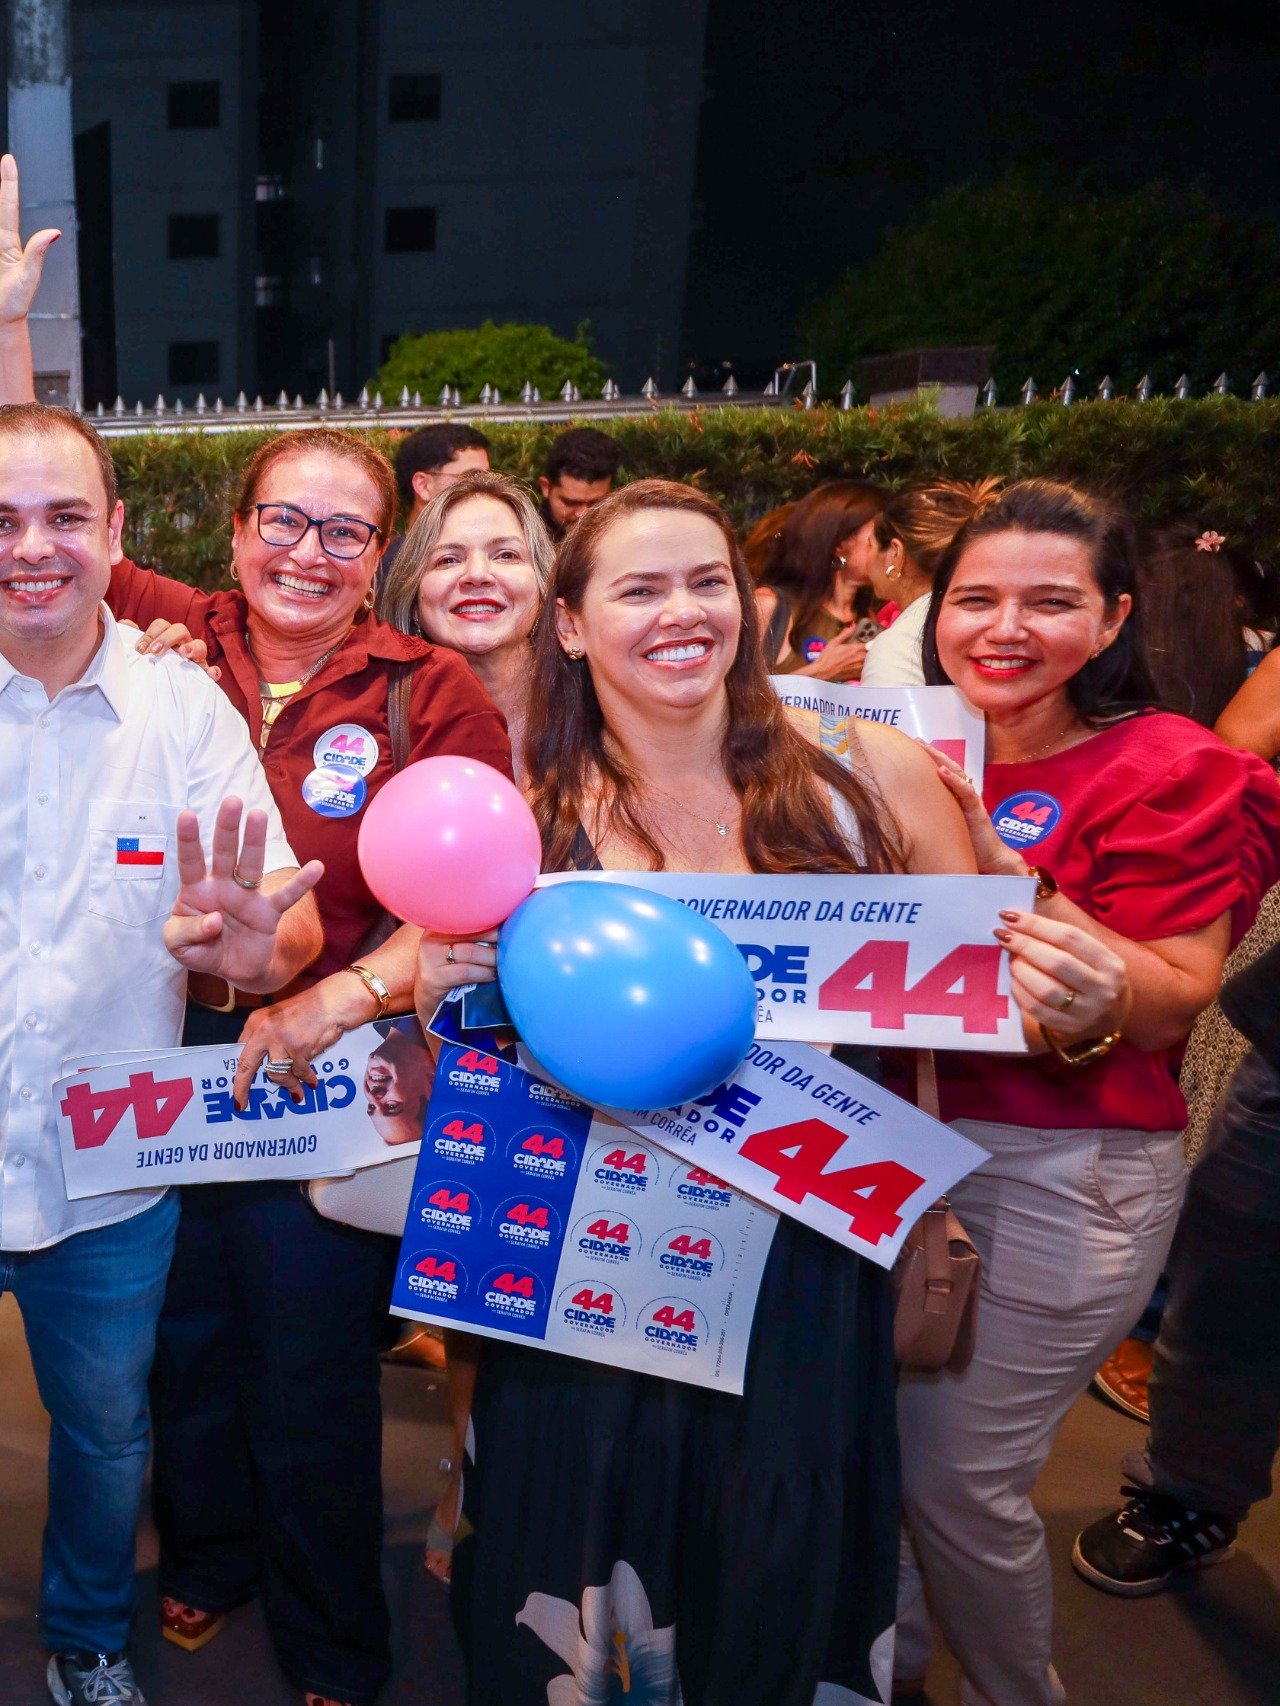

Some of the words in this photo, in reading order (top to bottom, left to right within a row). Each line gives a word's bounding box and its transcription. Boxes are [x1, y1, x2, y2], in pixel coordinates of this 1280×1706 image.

[329, 734, 365, 755] 44
[323, 752, 366, 766] CIDADE
[1010, 801, 1053, 826] 44
[999, 817, 1044, 836] CIDADE
[814, 900, 844, 922] DA
[850, 901, 922, 924] GENTE
[818, 939, 1009, 1034] 44
[457, 1051, 499, 1074] 44
[449, 1071, 501, 1087] CIDADE
[449, 1081, 499, 1092] GOVERNADOR
[529, 1094, 580, 1107] GOVERNADOR
[780, 1067, 815, 1092] DA
[811, 1083, 881, 1126] GENTE
[60, 1071, 194, 1150] 44
[443, 1120, 484, 1144] 44
[650, 1112, 697, 1146] CORRÊA
[188, 1143, 209, 1162] DA
[213, 1134, 318, 1160] GOVERNADOR
[435, 1139, 486, 1157] CIDADE
[435, 1149, 484, 1161] GOVERNADOR
[522, 1134, 564, 1159] 44
[136, 1148, 184, 1168] GENTE
[514, 1154, 566, 1172] CIDADE
[603, 1149, 646, 1174] 44
[514, 1164, 564, 1177] GOVERNADOR
[595, 1169, 648, 1187] CIDADE
[594, 1179, 646, 1192] GOVERNADOR
[737, 1117, 927, 1246] 44
[429, 1189, 470, 1213] 44
[677, 1184, 732, 1203] CIDADE
[677, 1195, 729, 1207] GOVERNADOR
[422, 1208, 472, 1226] CIDADE
[422, 1218, 470, 1231] GOVERNADOR
[507, 1204, 548, 1228] 44
[499, 1223, 550, 1241] CIDADE
[499, 1233, 549, 1246] GOVERNADOR
[587, 1219, 629, 1243] 44
[579, 1238, 631, 1257] CIDADE
[579, 1249, 629, 1261] GOVERNADOR
[668, 1235, 711, 1260] 44
[416, 1257, 456, 1281] 44
[659, 1265, 711, 1277] GOVERNADOR
[660, 1254, 713, 1273] CIDADE
[408, 1275, 458, 1294] CIDADE
[408, 1286, 456, 1299] GOVERNADOR
[493, 1273, 534, 1297] 44
[485, 1292, 536, 1311] CIDADE
[485, 1302, 534, 1316] GOVERNADOR
[572, 1289, 613, 1314] 44
[564, 1308, 616, 1328] CIDADE
[564, 1319, 614, 1333] GOVERNADOR
[653, 1306, 695, 1332] 44
[645, 1326, 698, 1346] CIDADE
[645, 1337, 696, 1351] GOVERNADOR
